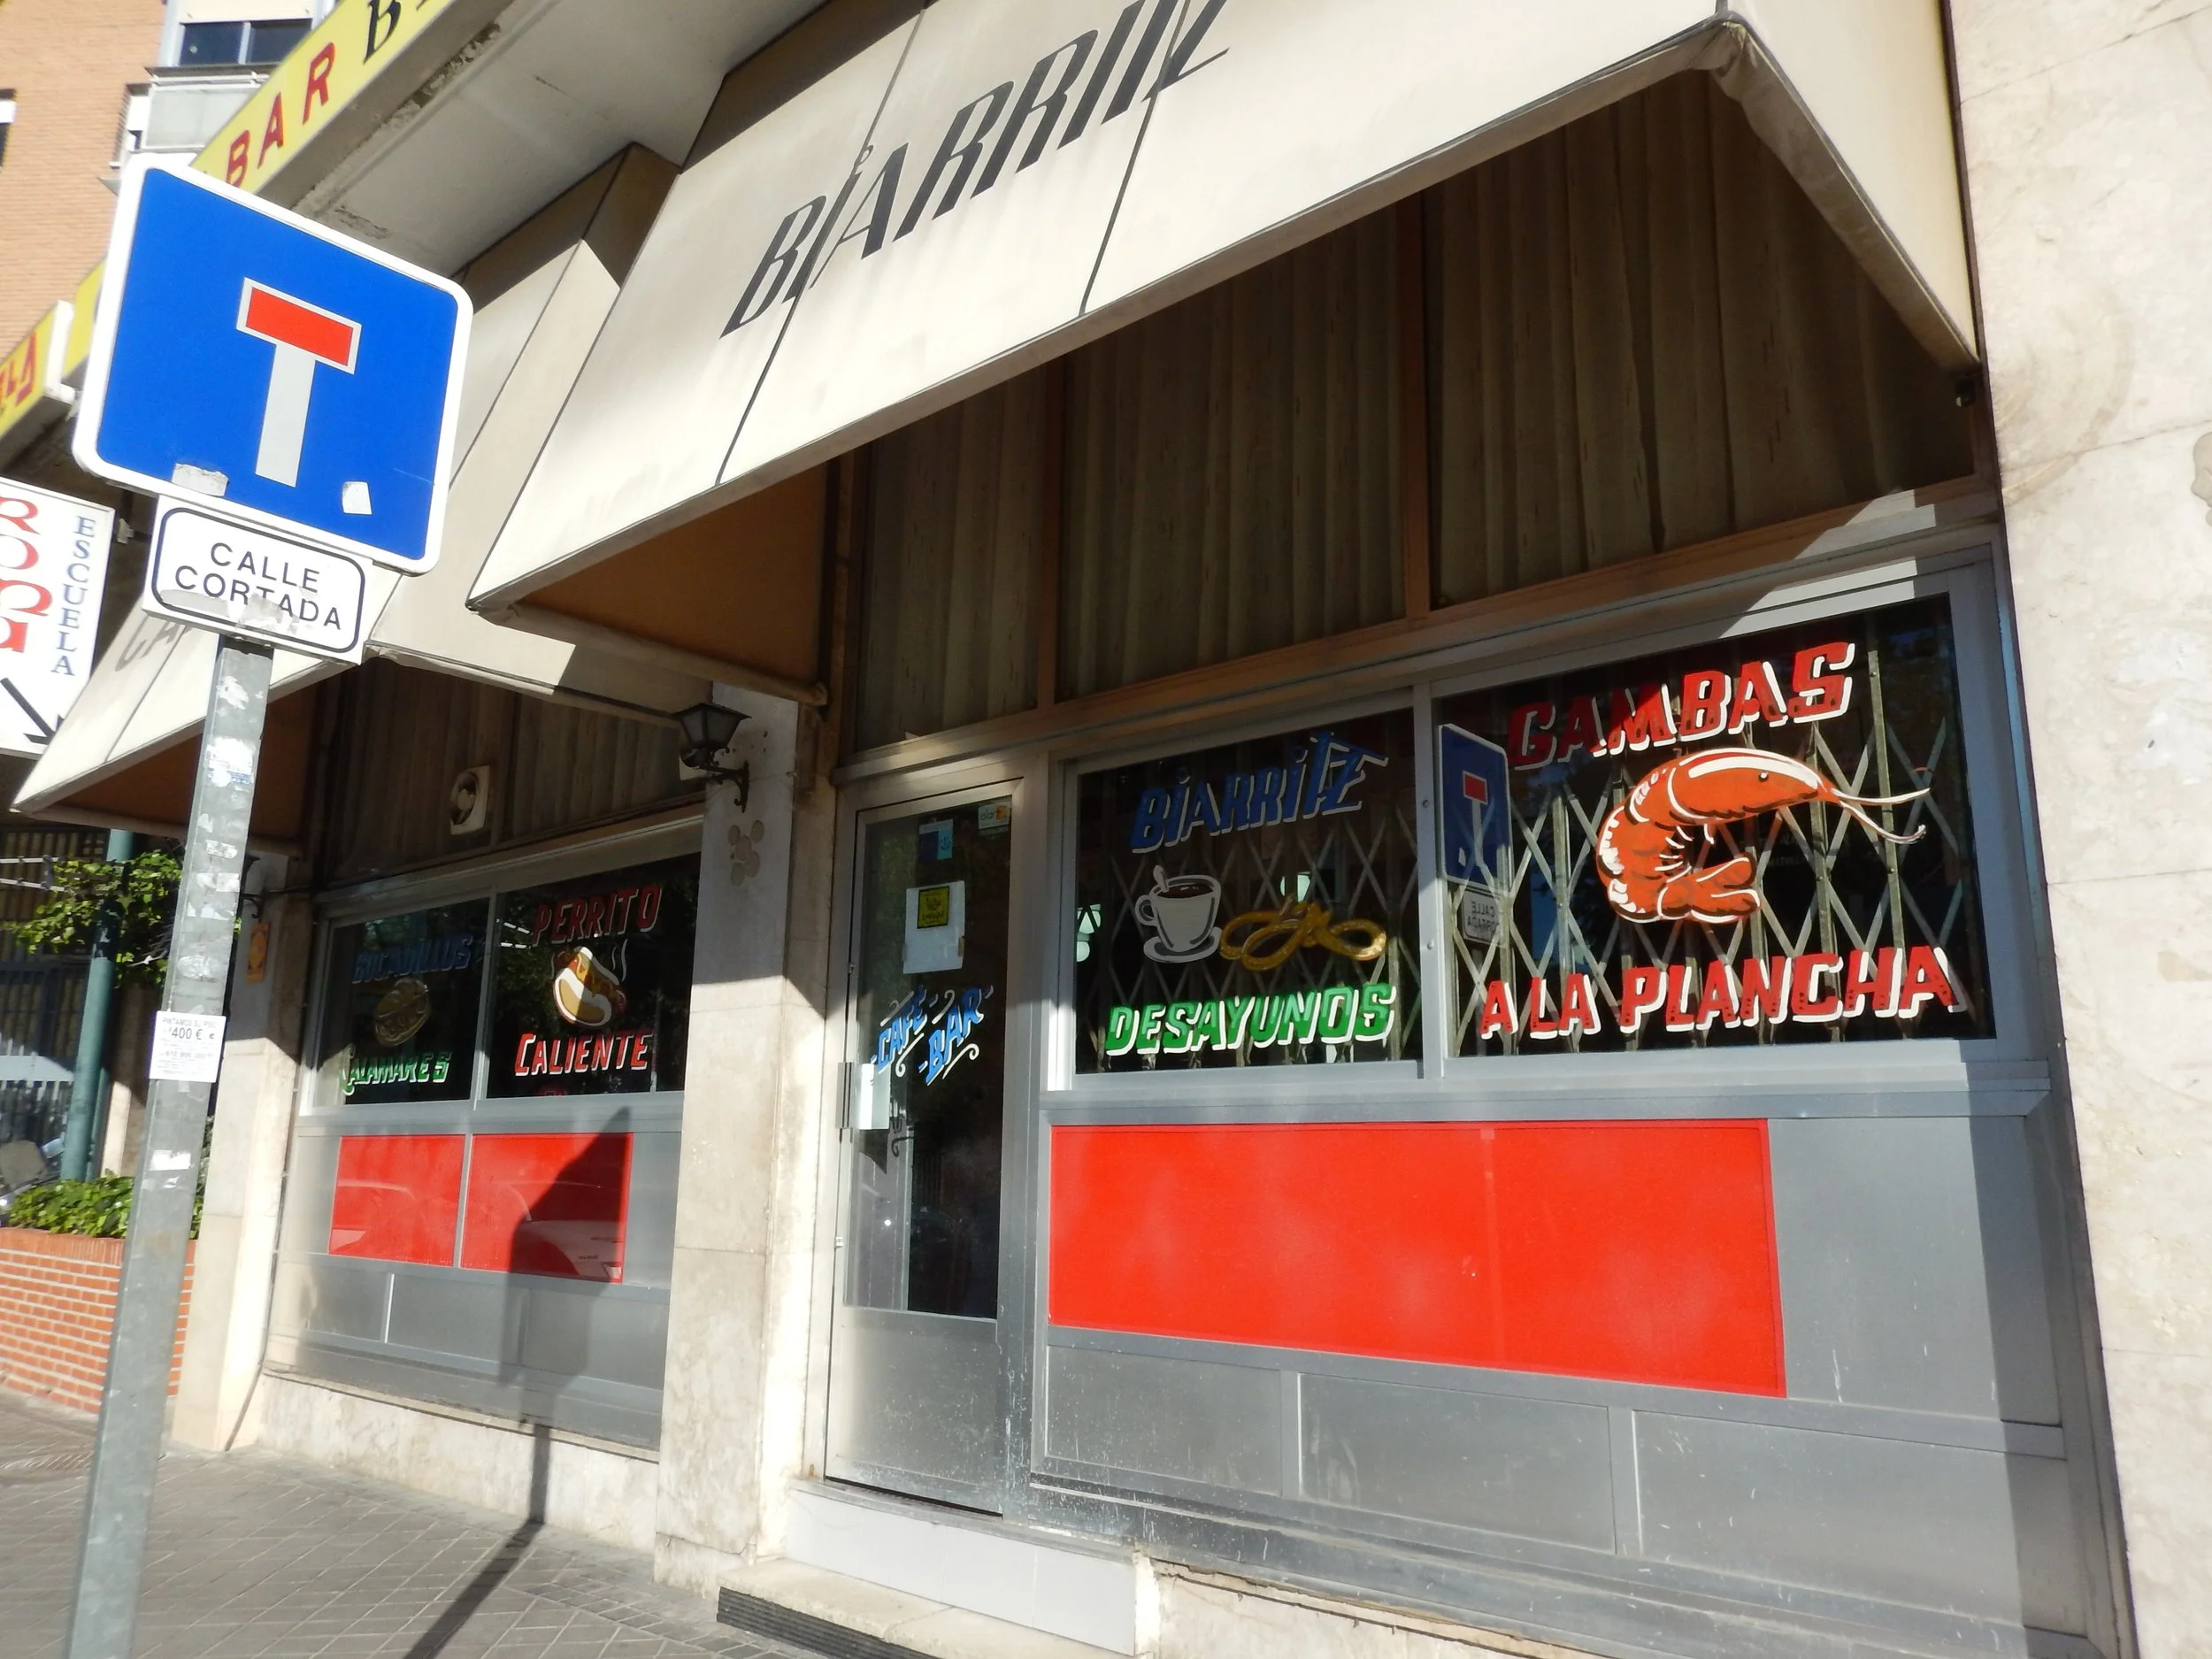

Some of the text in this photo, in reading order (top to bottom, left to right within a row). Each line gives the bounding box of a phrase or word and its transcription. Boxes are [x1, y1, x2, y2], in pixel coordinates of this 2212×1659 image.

[227, 42, 335, 188] BAR
[50, 516, 96, 676] ESCUELA
[175, 565, 341, 630] CORTADA
[211, 542, 319, 594] CALLE
[1506, 641, 1856, 771] GAMBAS
[532, 885, 662, 947] PERRITO
[1105, 982, 1396, 1056] DESAYUNOS
[1480, 946, 1967, 1039] A LA PLANCHA
[514, 1028, 653, 1077] CALIENTE
[926, 987, 985, 1086] BAR
